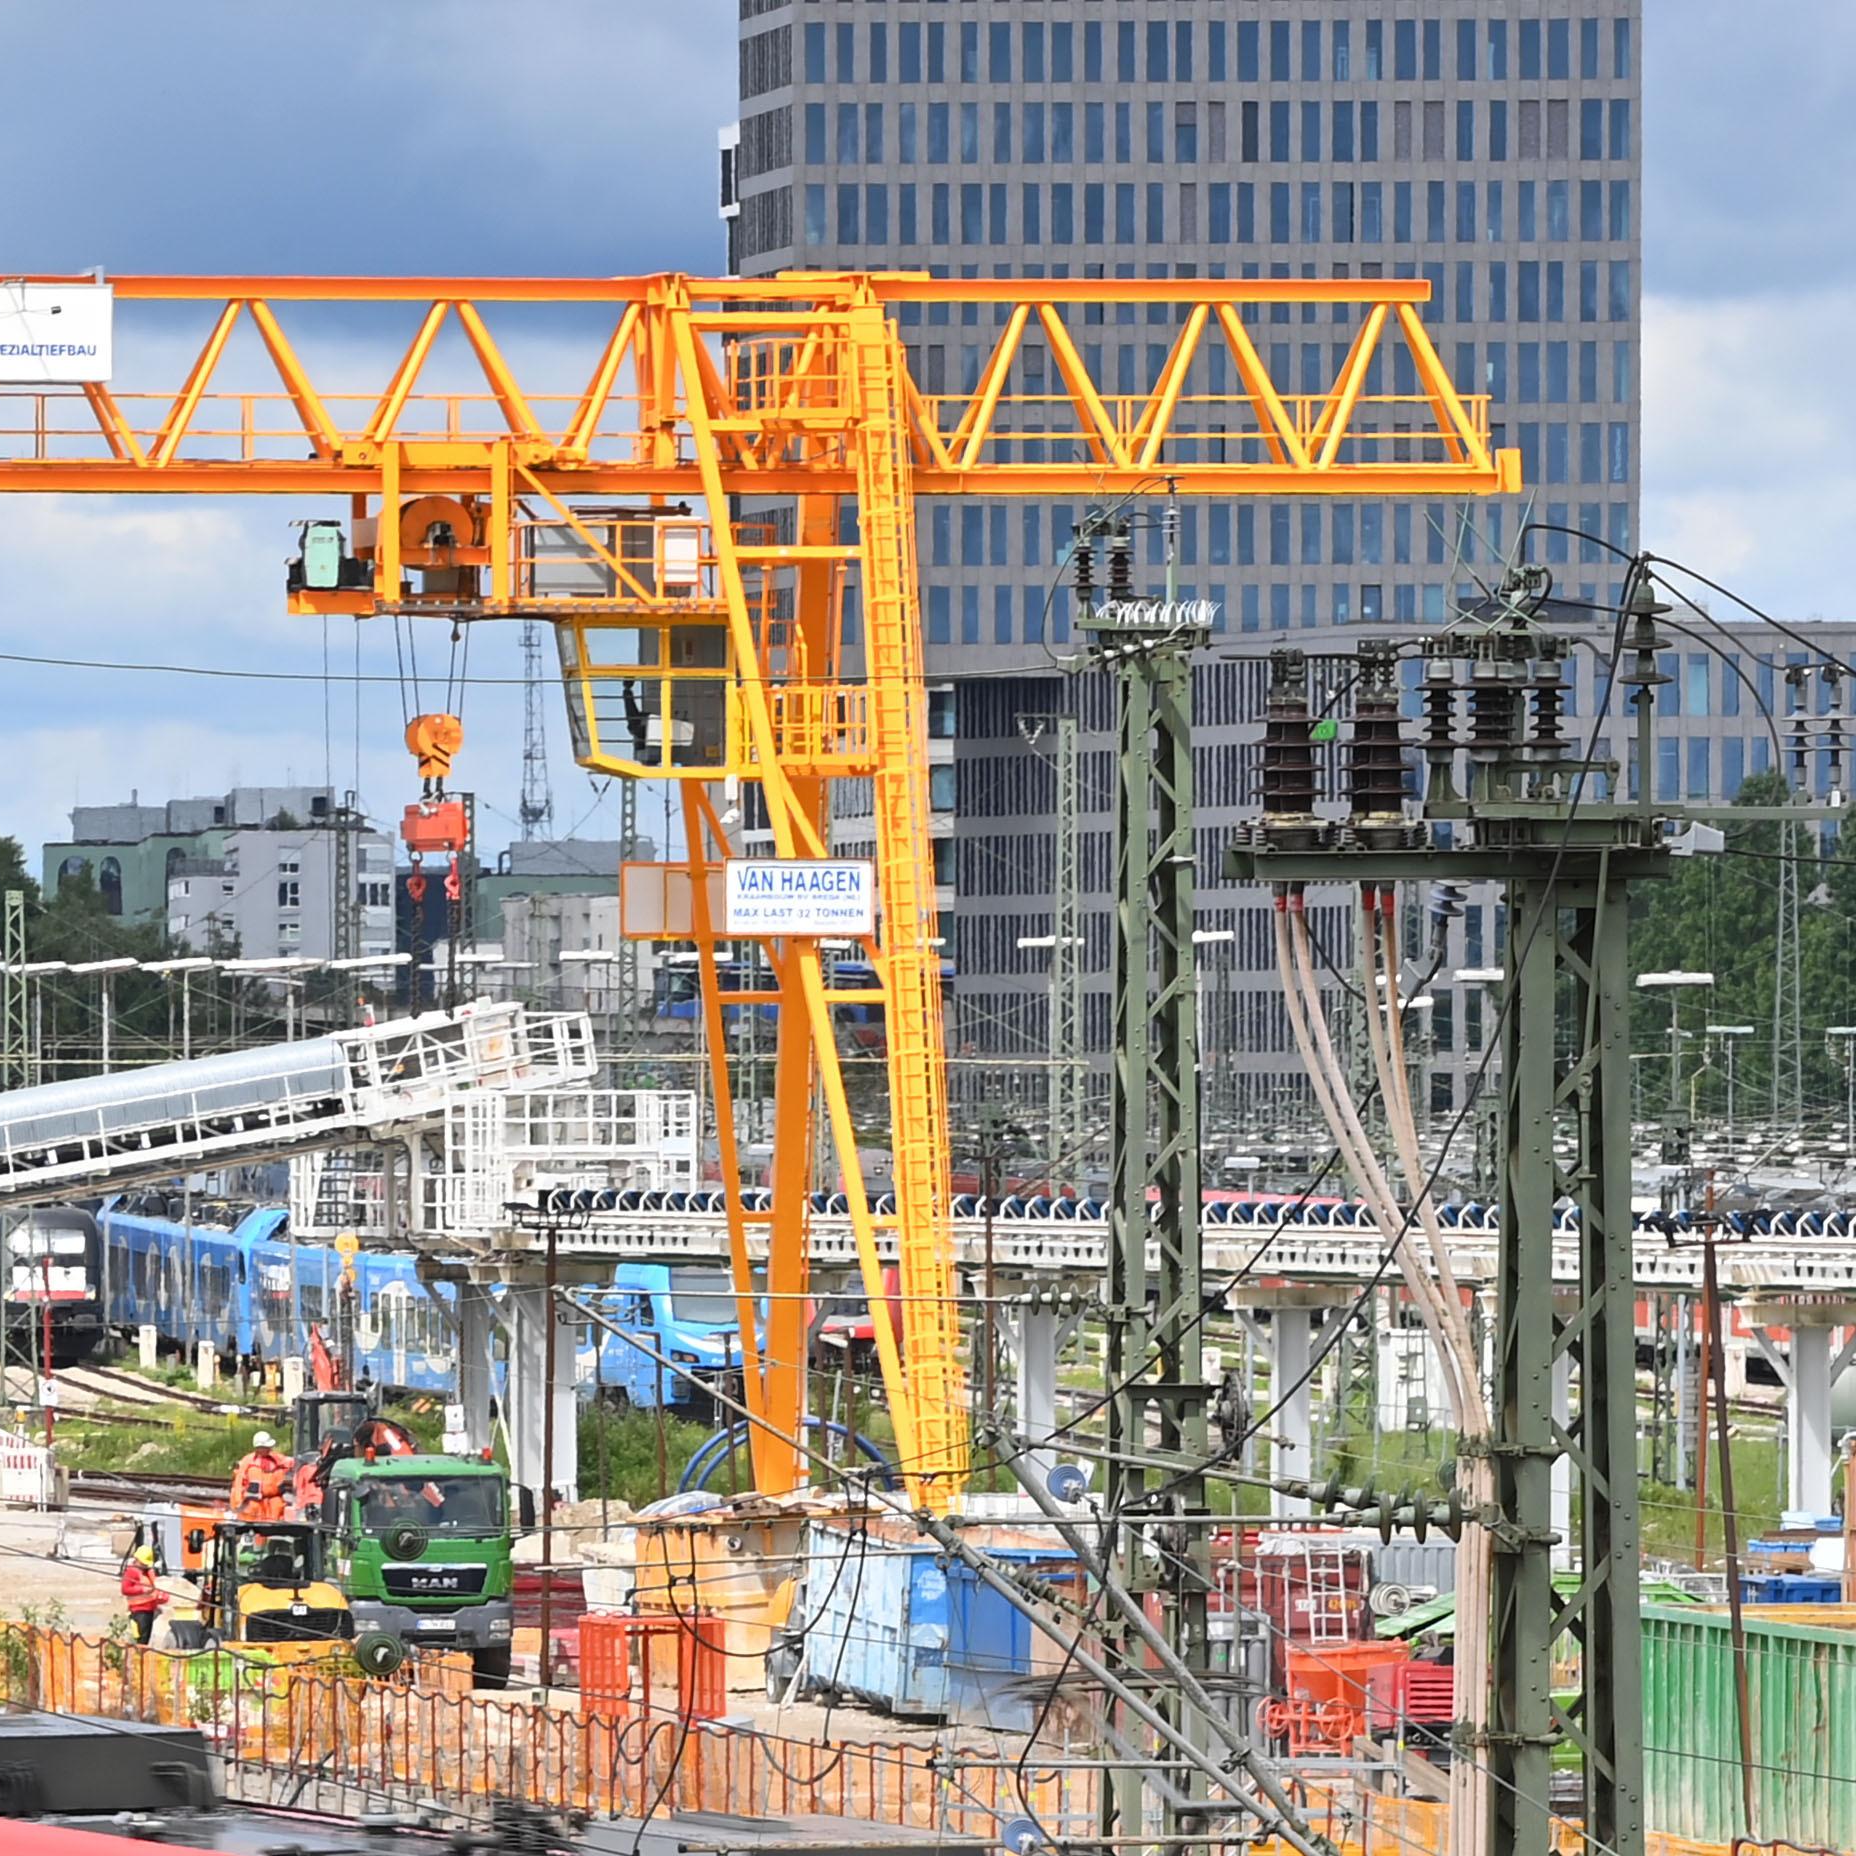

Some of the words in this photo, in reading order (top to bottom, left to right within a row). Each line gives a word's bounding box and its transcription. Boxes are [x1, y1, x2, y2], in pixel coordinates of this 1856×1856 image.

[737, 870, 774, 892] VAN
[781, 870, 861, 892] HAAGEN
[733, 908, 759, 917] MAX
[763, 908, 793, 917] LAST
[797, 909, 814, 918] 32
[816, 907, 864, 918] TONNEN
[410, 1576, 459, 1589] MAN
